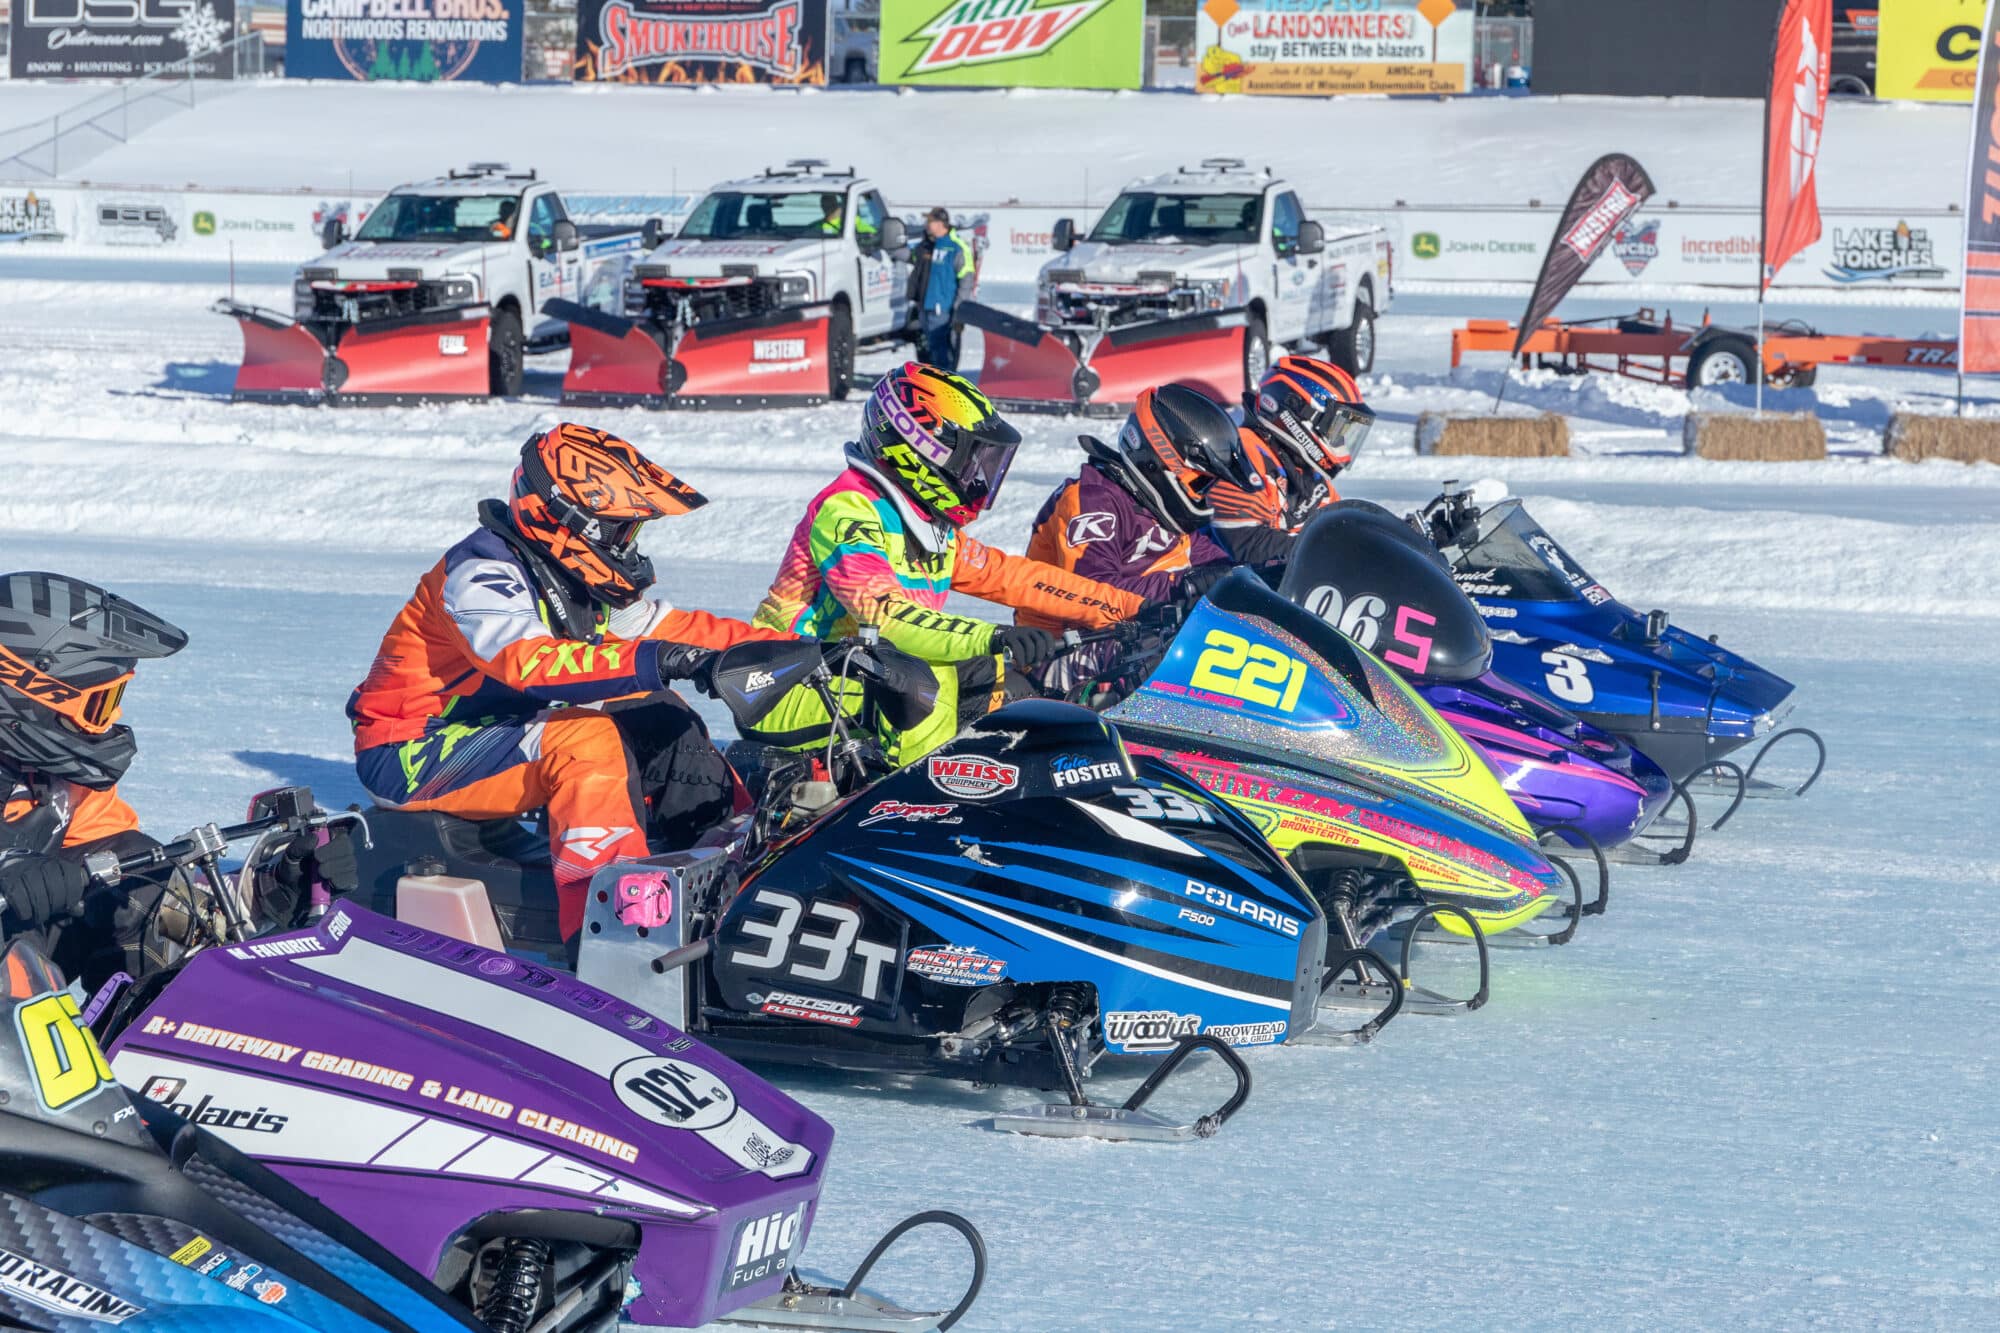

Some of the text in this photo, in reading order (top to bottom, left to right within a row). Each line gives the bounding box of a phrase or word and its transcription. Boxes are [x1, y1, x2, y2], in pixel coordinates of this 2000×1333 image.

[302, 19, 508, 41] NORTHWOODS RENOVATIONS
[608, 6, 797, 68] SMOKEHOUSE
[1250, 42, 1425, 60] stay BETWEEN the blazers
[27, 62, 64, 73] SNOW
[75, 61, 132, 73] HUNTING
[220, 220, 296, 232] JOHN DEERE
[1445, 240, 1537, 253] JOHN DEERE
[1833, 228, 1894, 249] LAKE
[1832, 250, 1933, 269] TORCHES
[876, 383, 949, 460] SCOTT
[1033, 580, 1075, 601] RACE
[1303, 585, 1386, 650] 06
[1190, 630, 1308, 713] 221
[1541, 651, 1594, 704] 3
[931, 759, 1017, 787] WEISS
[945, 777, 993, 789] EQUIPMENT
[1053, 762, 1122, 788] FOSTER
[1178, 909, 1216, 927] F500
[1184, 879, 1300, 938] POLARIS
[253, 936, 327, 960] FAVORITE
[732, 890, 897, 1000] 33T
[906, 963, 952, 975] SLEDS
[907, 949, 1006, 974] MICKEY'S
[764, 991, 864, 1016] PRECISION
[766, 1005, 854, 1025] FLEET IMAGE
[1204, 1022, 1286, 1038] ARROWHEAD
[1250, 1034, 1274, 1044] GRILL
[142, 1015, 641, 1165] A+ DRIVEWAY GRADING & LAND CLEARING
[139, 1076, 289, 1135] Polaris
[731, 1260, 771, 1287] Fuel
